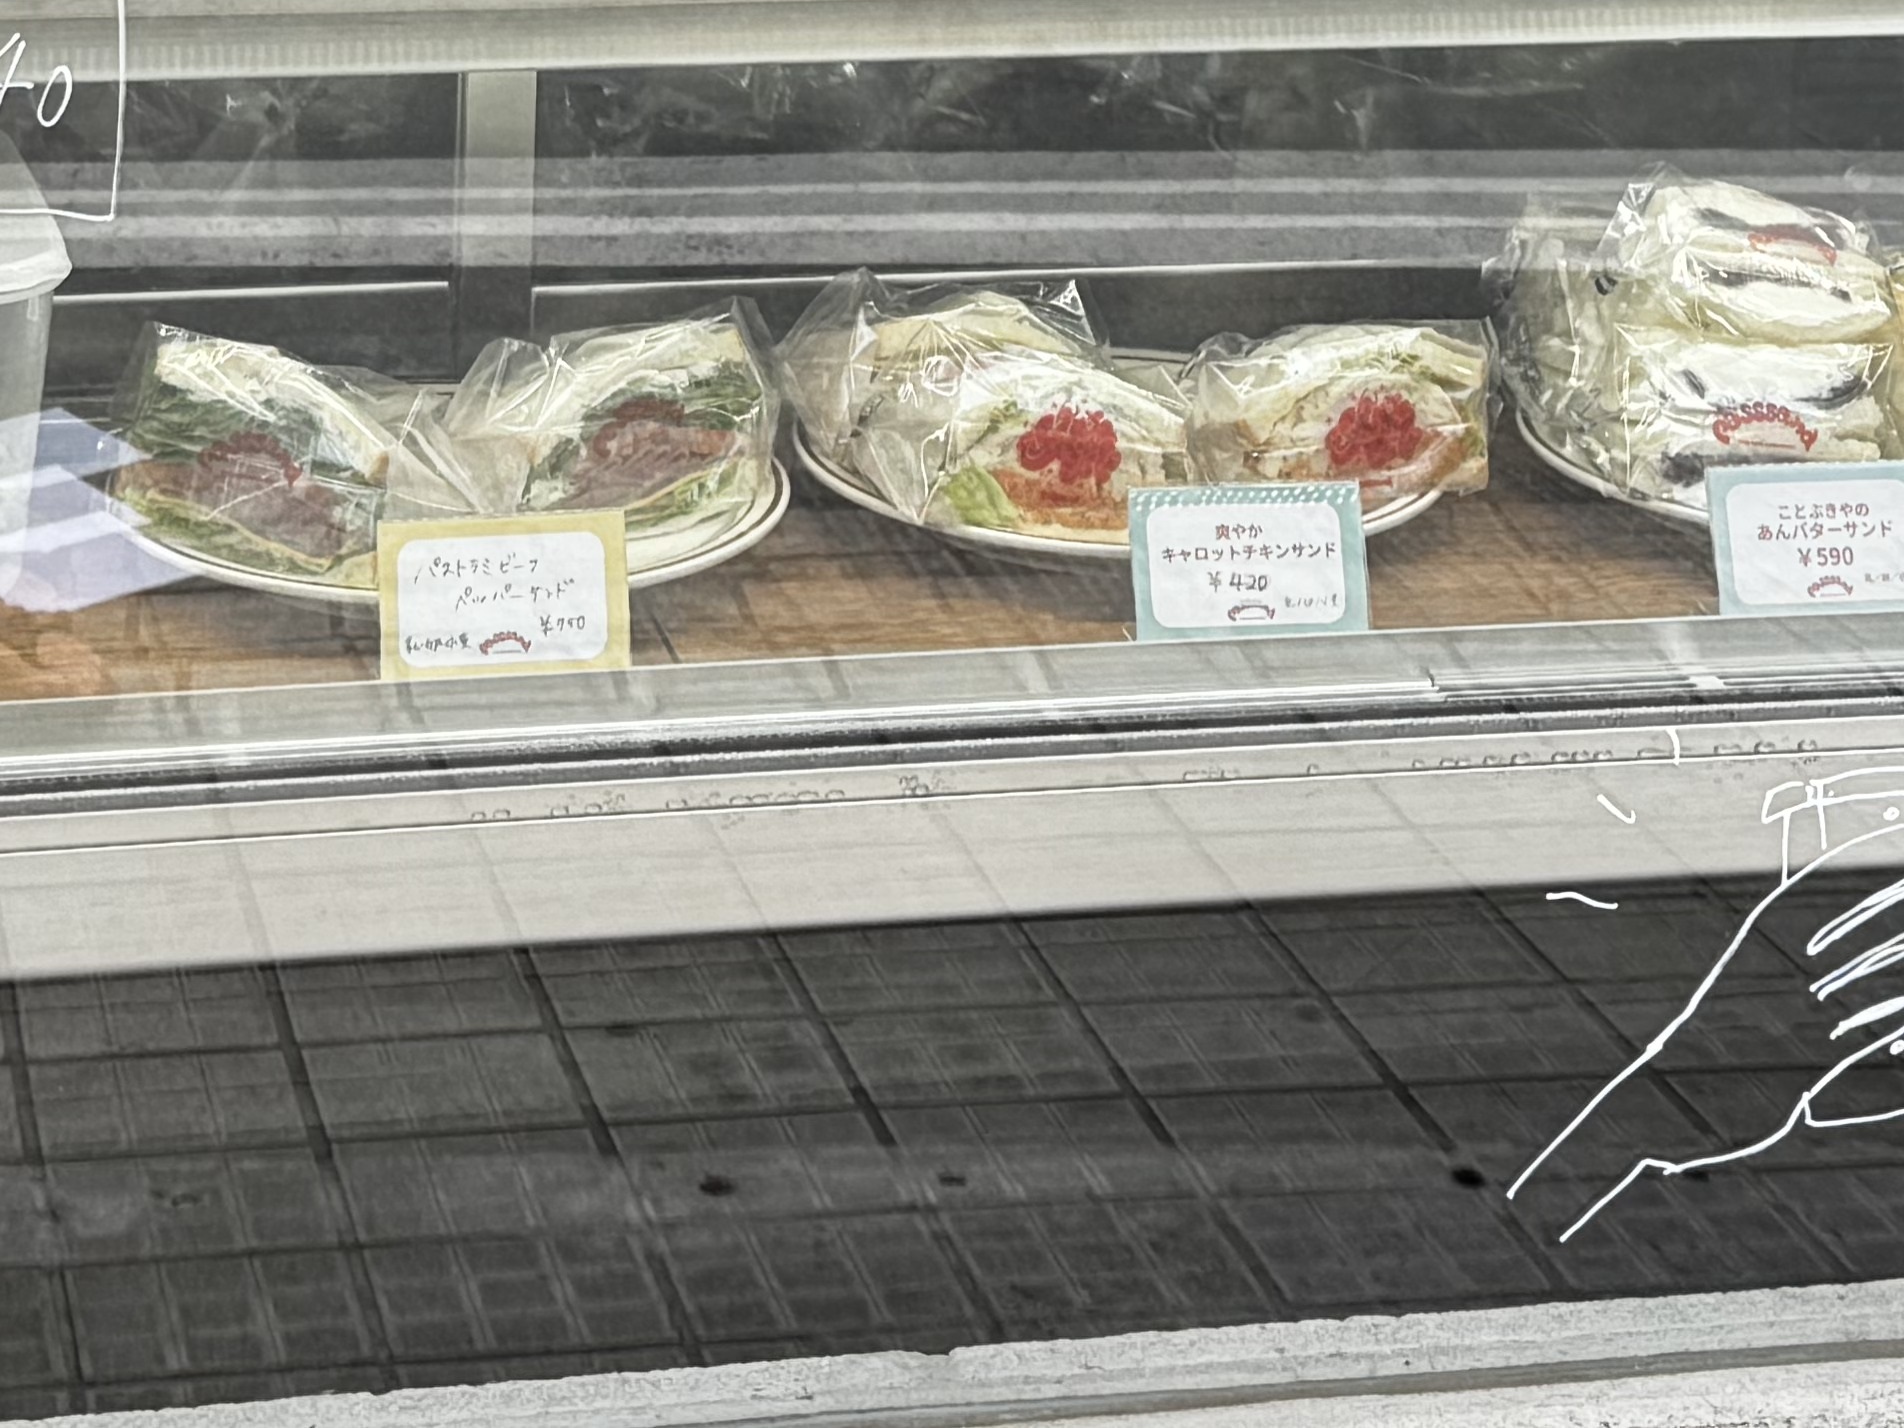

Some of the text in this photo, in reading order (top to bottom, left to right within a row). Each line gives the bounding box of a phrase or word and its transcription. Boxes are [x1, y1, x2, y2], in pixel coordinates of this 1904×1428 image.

[1778, 503, 1869, 520] ことぶきやの
[1216, 523, 1263, 540] 爽やか
[1757, 520, 1893, 541] あんバターサンド
[1162, 542, 1336, 562] キャロットチキンサンド
[1797, 546, 1854, 567] ¥590
